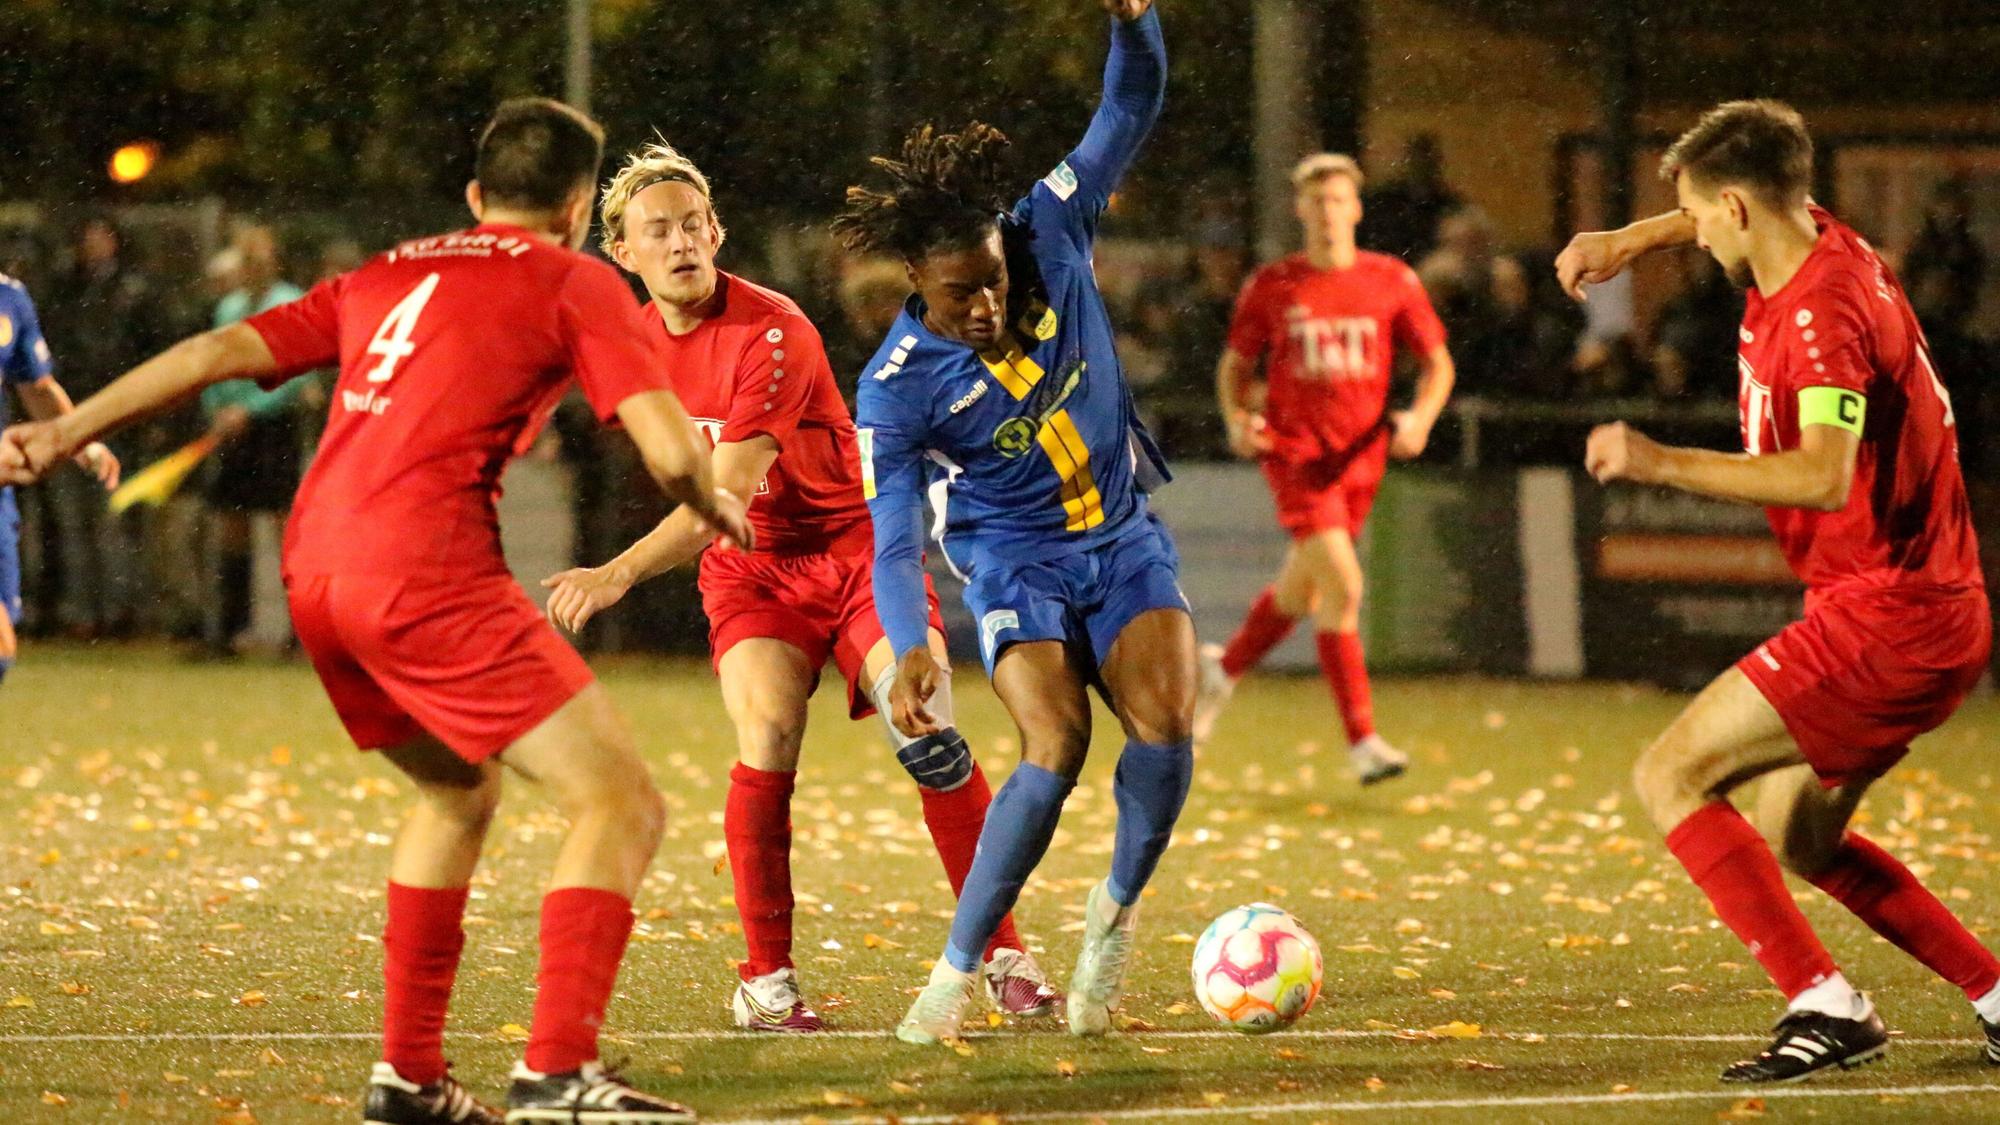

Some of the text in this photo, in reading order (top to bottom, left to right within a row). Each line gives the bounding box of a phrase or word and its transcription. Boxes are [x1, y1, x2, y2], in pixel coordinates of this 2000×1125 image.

[367, 272, 440, 382] 4
[950, 379, 988, 413] capelli
[1839, 393, 1859, 425] C
